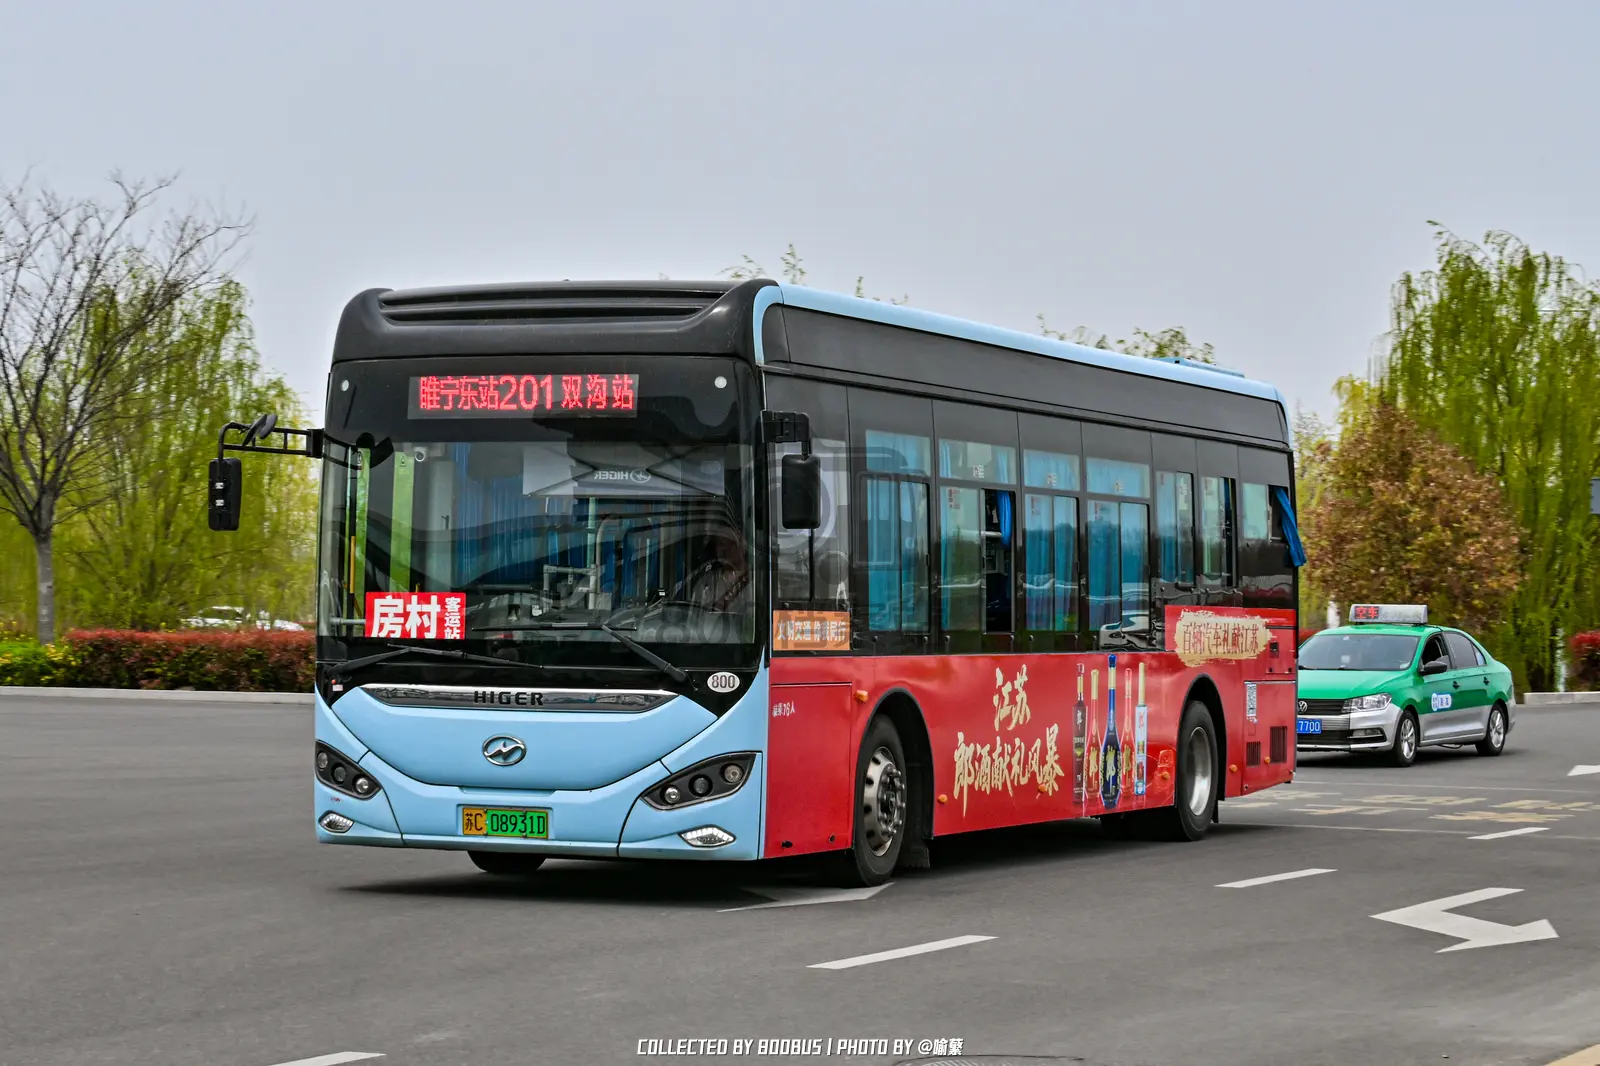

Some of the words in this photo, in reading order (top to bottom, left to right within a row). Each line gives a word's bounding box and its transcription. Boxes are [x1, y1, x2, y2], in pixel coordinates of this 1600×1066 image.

[561, 374, 633, 410] 双沟站
[371, 595, 441, 638] 房村
[444, 597, 461, 639] 客运站
[1355, 606, 1379, 619] 空车
[711, 674, 736, 689] 800
[474, 690, 543, 706] HIGER
[993, 664, 1032, 731] 江苏
[1297, 721, 1320, 732] 7700
